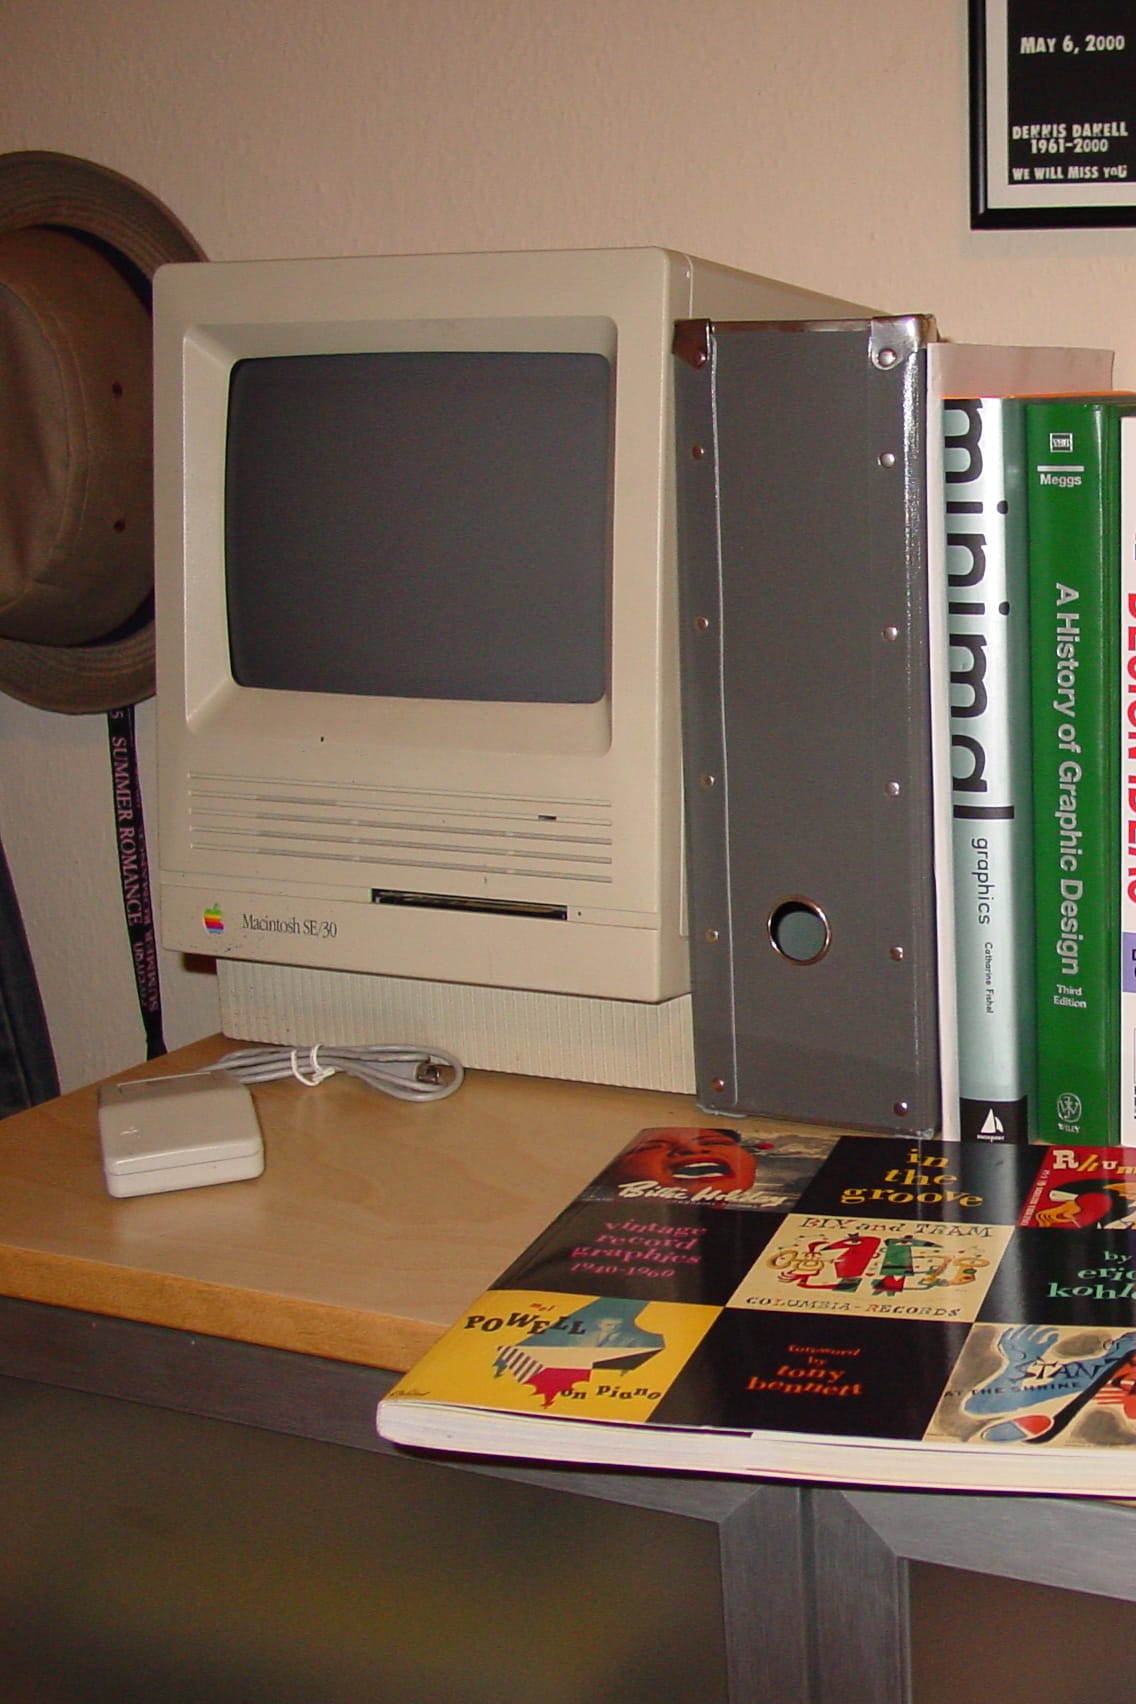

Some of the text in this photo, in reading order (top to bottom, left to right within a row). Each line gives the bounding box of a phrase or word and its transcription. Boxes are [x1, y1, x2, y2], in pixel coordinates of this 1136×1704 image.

[1020, 36, 1056, 54] MAY
[1062, 35, 1080, 54] 6,
[1085, 34, 1125, 52] 2000
[1012, 121, 1128, 140] DENNIS DANELL
[1030, 138, 1109, 154] 1961-2000
[1012, 167, 1030, 181] WE
[1034, 166, 1064, 180] WILL
[1068, 165, 1099, 179] MISS
[1040, 473, 1082, 488] Meggs
[111, 736, 135, 822] SUMMER
[1055, 583, 1084, 975] A History of Graphic Design
[119, 827, 143, 926] ROMANCE
[971, 838, 995, 924] graphics
[242, 913, 338, 938] Macintosh SE/30
[1056, 984, 1082, 996] Third
[1053, 995, 1087, 1008] Edition
[906, 1147, 949, 1168] in
[883, 1166, 958, 1185] the
[617, 1180, 689, 1200] Billie
[690, 1185, 788, 1208] Holiday
[840, 1183, 984, 1208] groove
[603, 1218, 708, 1237] vintage
[915, 1223, 993, 1238] TRAM
[595, 1233, 700, 1251] record
[569, 1244, 702, 1265] graphics
[1103, 1250, 1133, 1264] by
[569, 1262, 676, 1280] 1940-1960
[463, 1312, 587, 1335] POWELL
[775, 1364, 846, 1383] tony
[1010, 1355, 1101, 1384] STAN
[559, 1384, 662, 1401] on Piano
[746, 1376, 864, 1396] bennett
[970, 1385, 1006, 1396] THE
[1010, 1380, 1083, 1394] SHRINE
